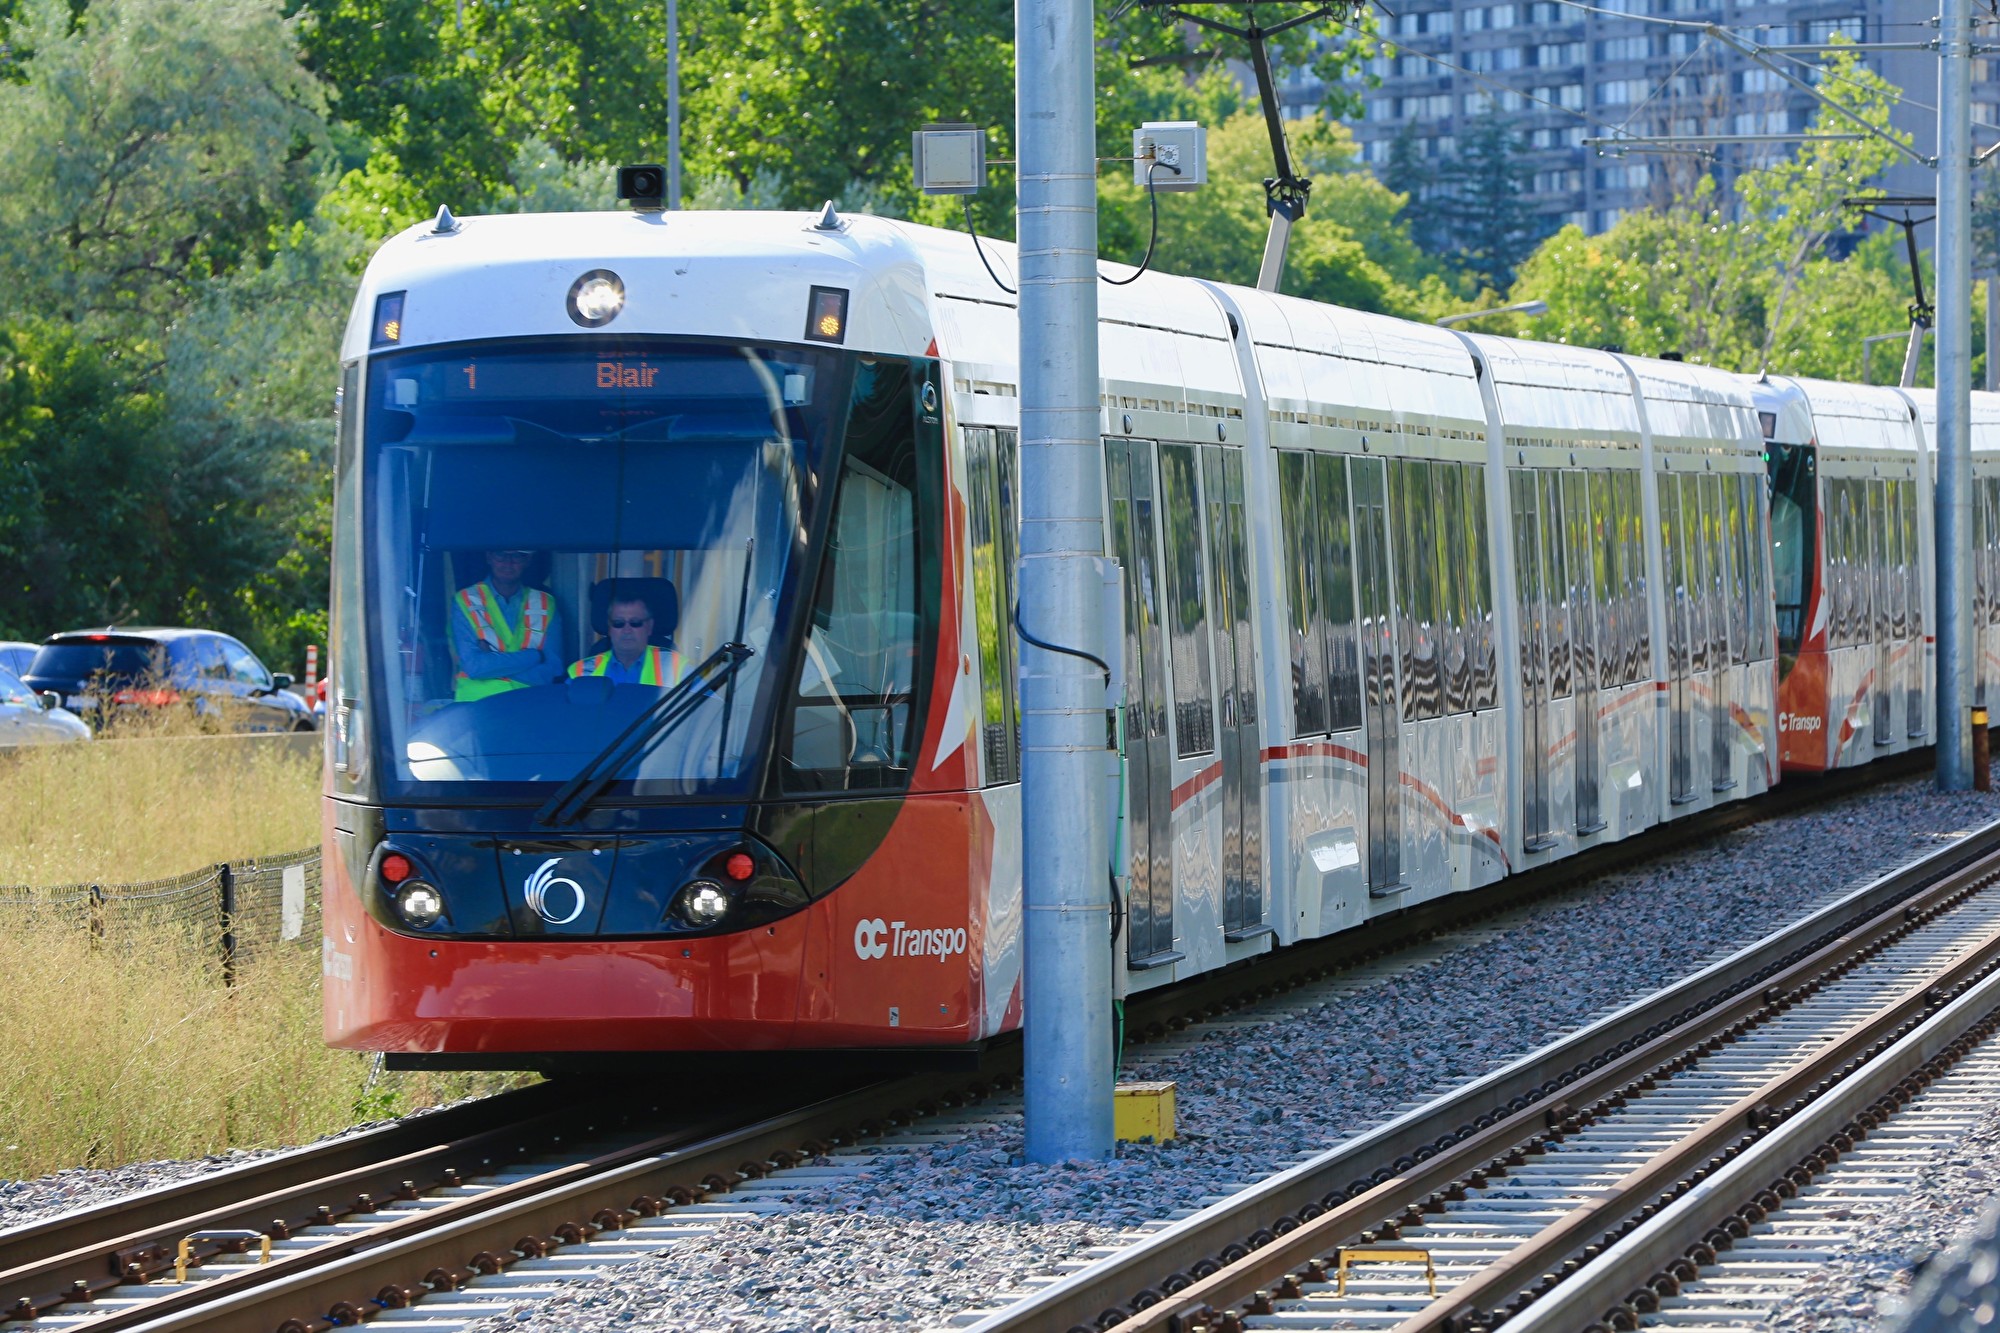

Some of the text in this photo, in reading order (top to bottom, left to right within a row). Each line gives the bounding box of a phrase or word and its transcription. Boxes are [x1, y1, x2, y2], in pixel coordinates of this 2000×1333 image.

[463, 362, 660, 390] 1 Blair
[1778, 711, 1822, 734] C Transpo
[854, 918, 967, 963] OC Transpo
